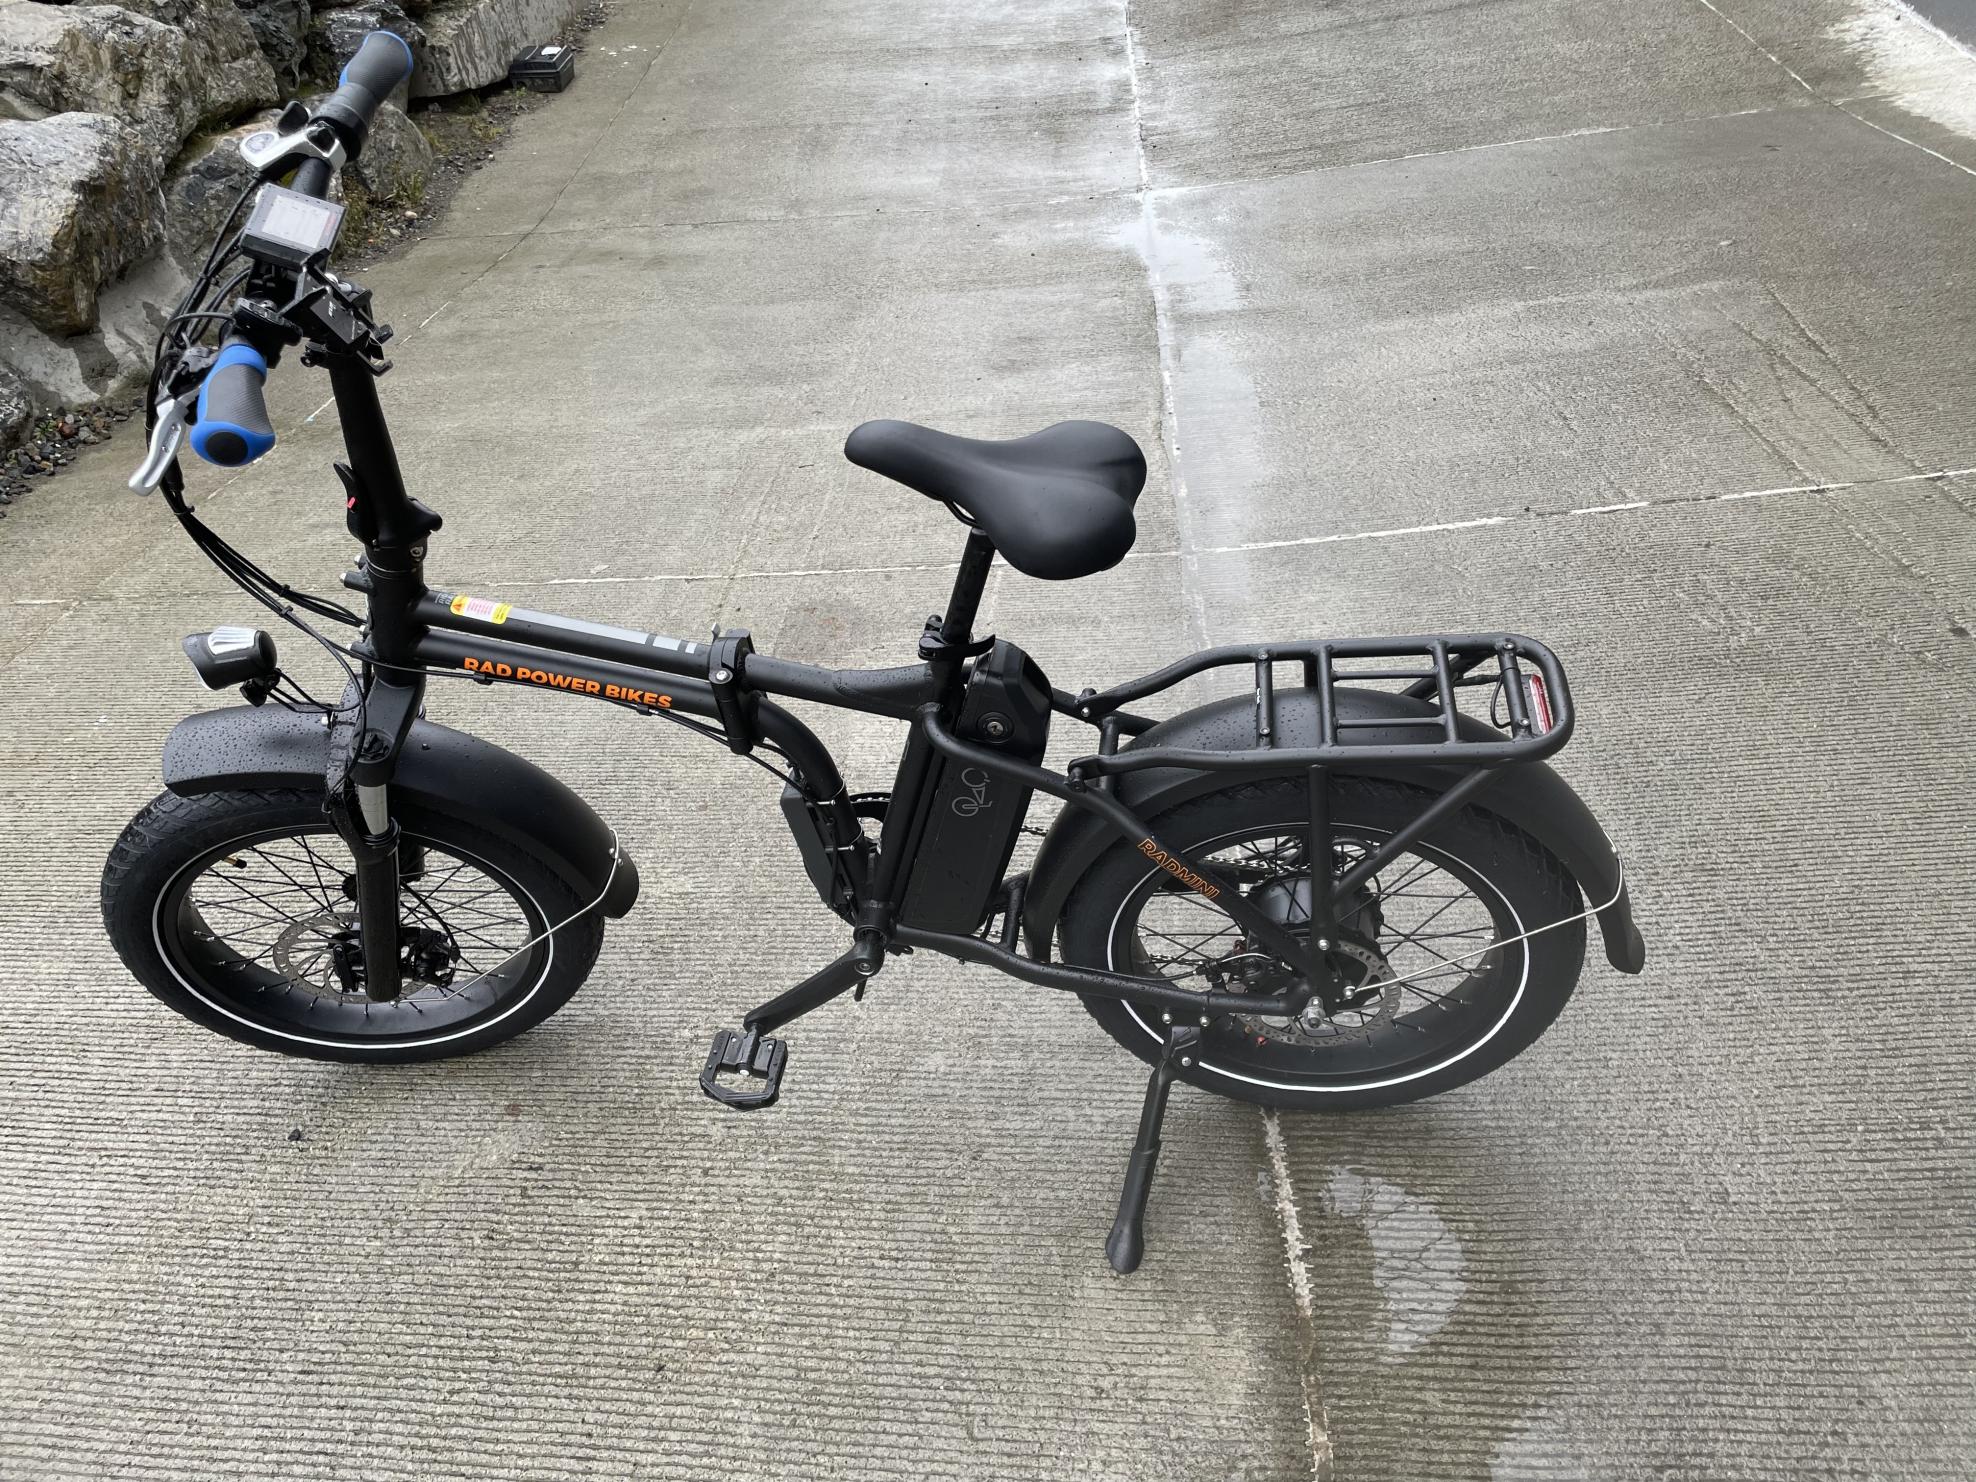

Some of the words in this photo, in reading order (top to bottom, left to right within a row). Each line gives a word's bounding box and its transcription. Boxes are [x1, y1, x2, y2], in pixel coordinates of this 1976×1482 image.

[464, 657, 512, 677] RAD
[516, 667, 601, 694] POWER
[605, 684, 673, 709] BIKES
[1137, 838, 1221, 900] RADMINI
